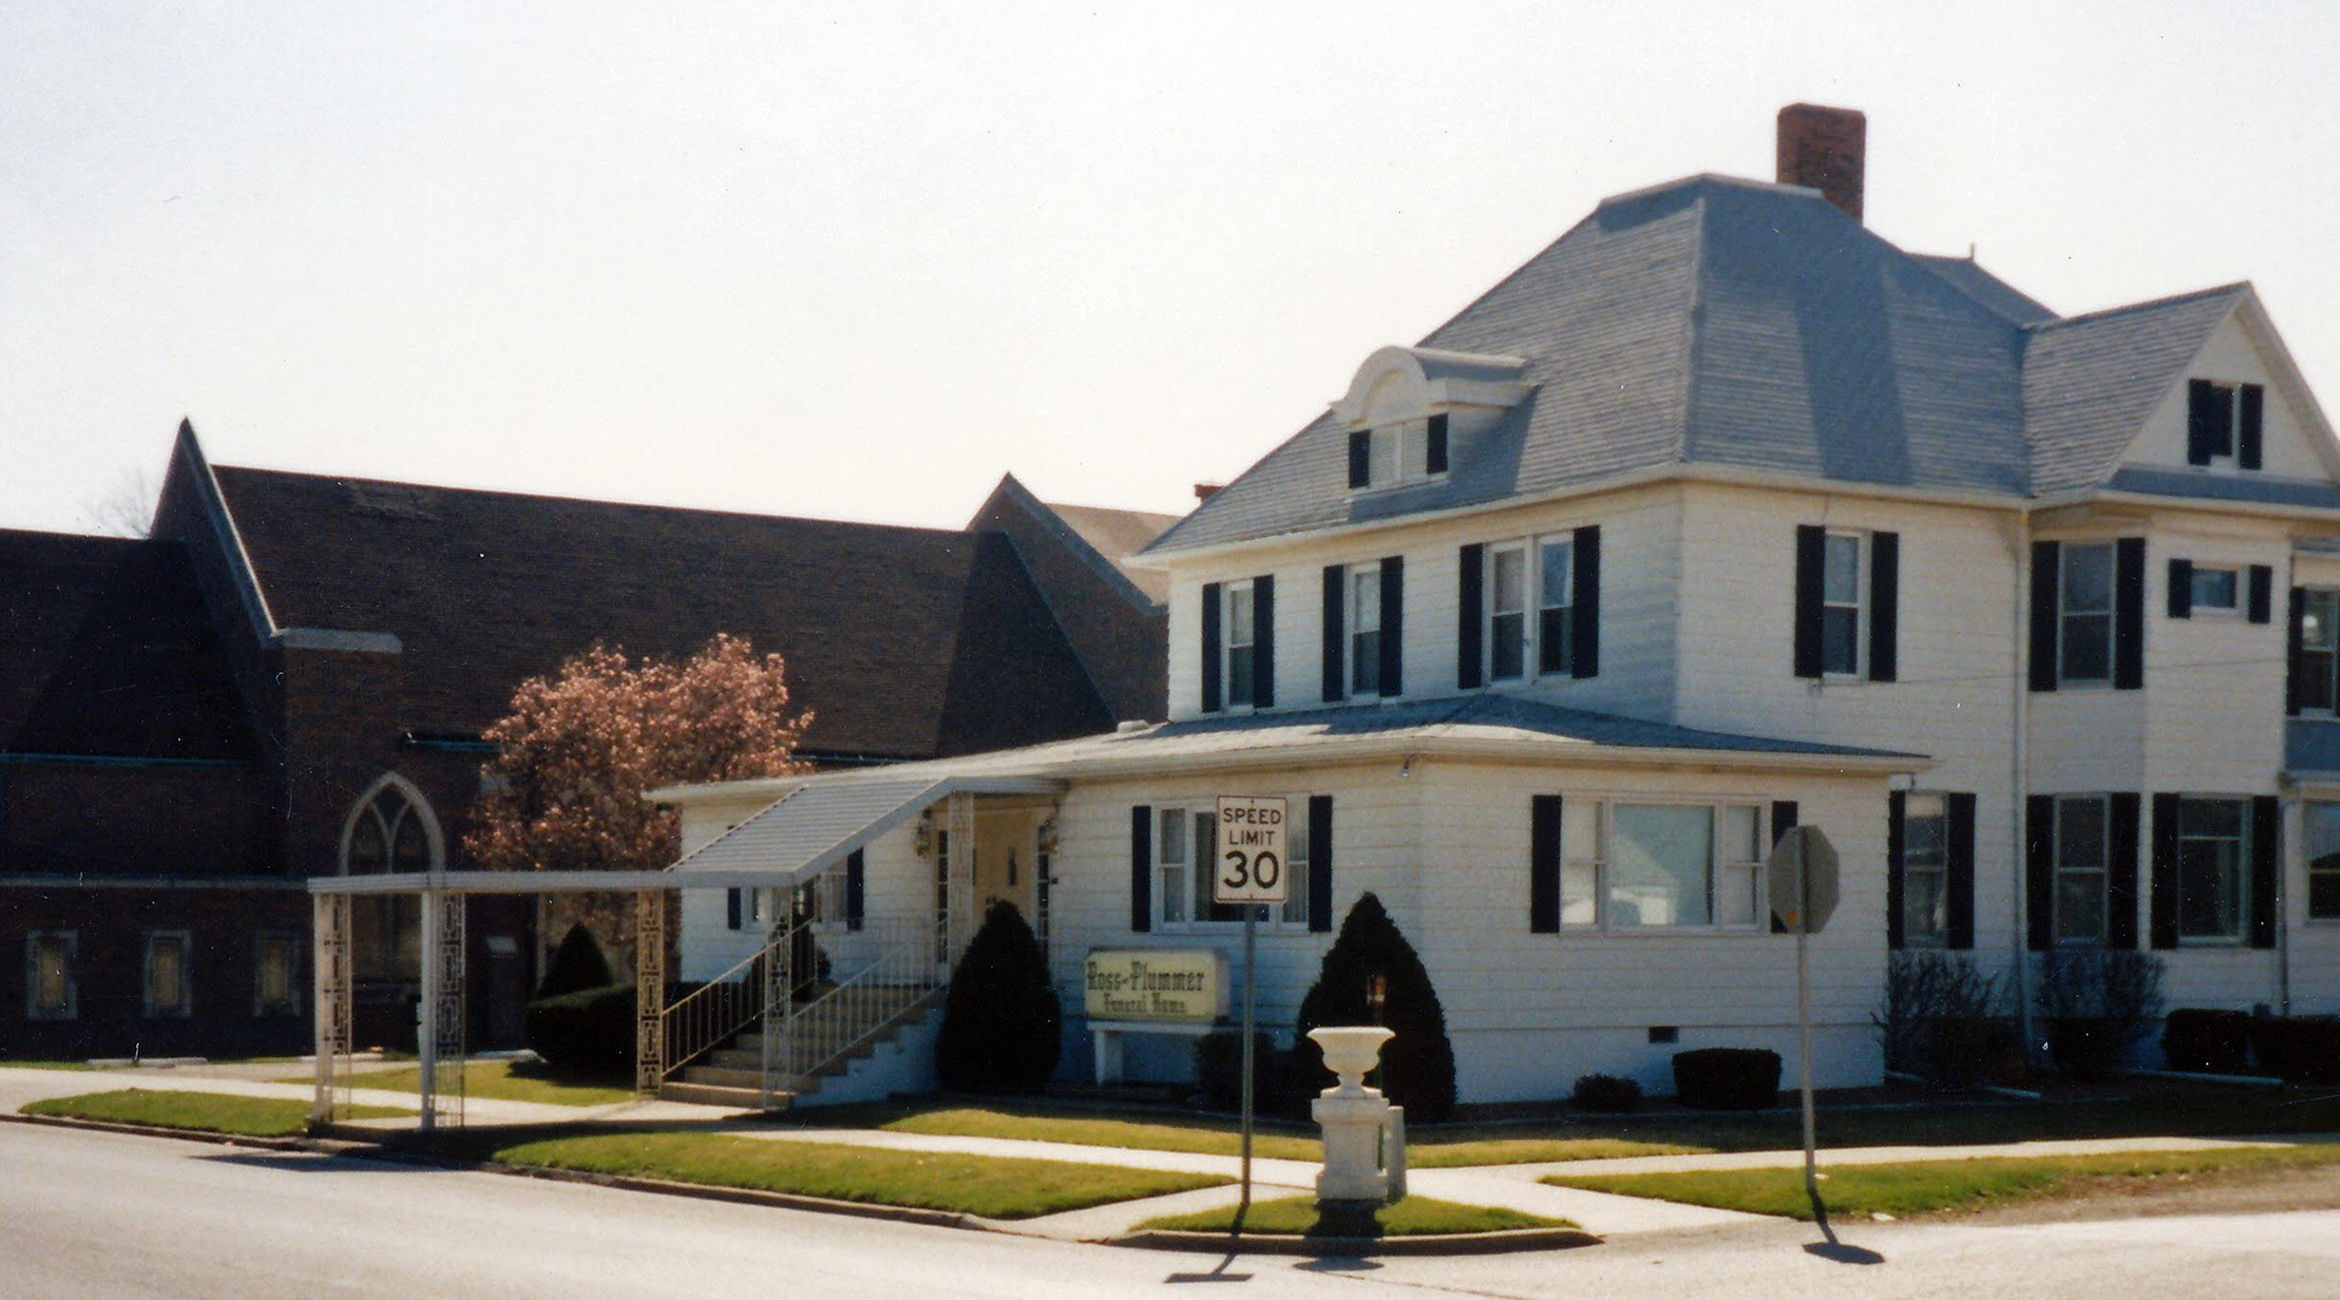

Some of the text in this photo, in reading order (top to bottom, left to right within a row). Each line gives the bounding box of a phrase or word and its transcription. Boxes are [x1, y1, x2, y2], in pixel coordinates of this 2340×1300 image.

[1223, 808, 1282, 825] SPEED
[1229, 830, 1275, 845] LIMIT
[1223, 850, 1279, 889] 30
[1087, 960, 1204, 991] Ross-Plummer
[1103, 992, 1187, 1013] Funeral Home
